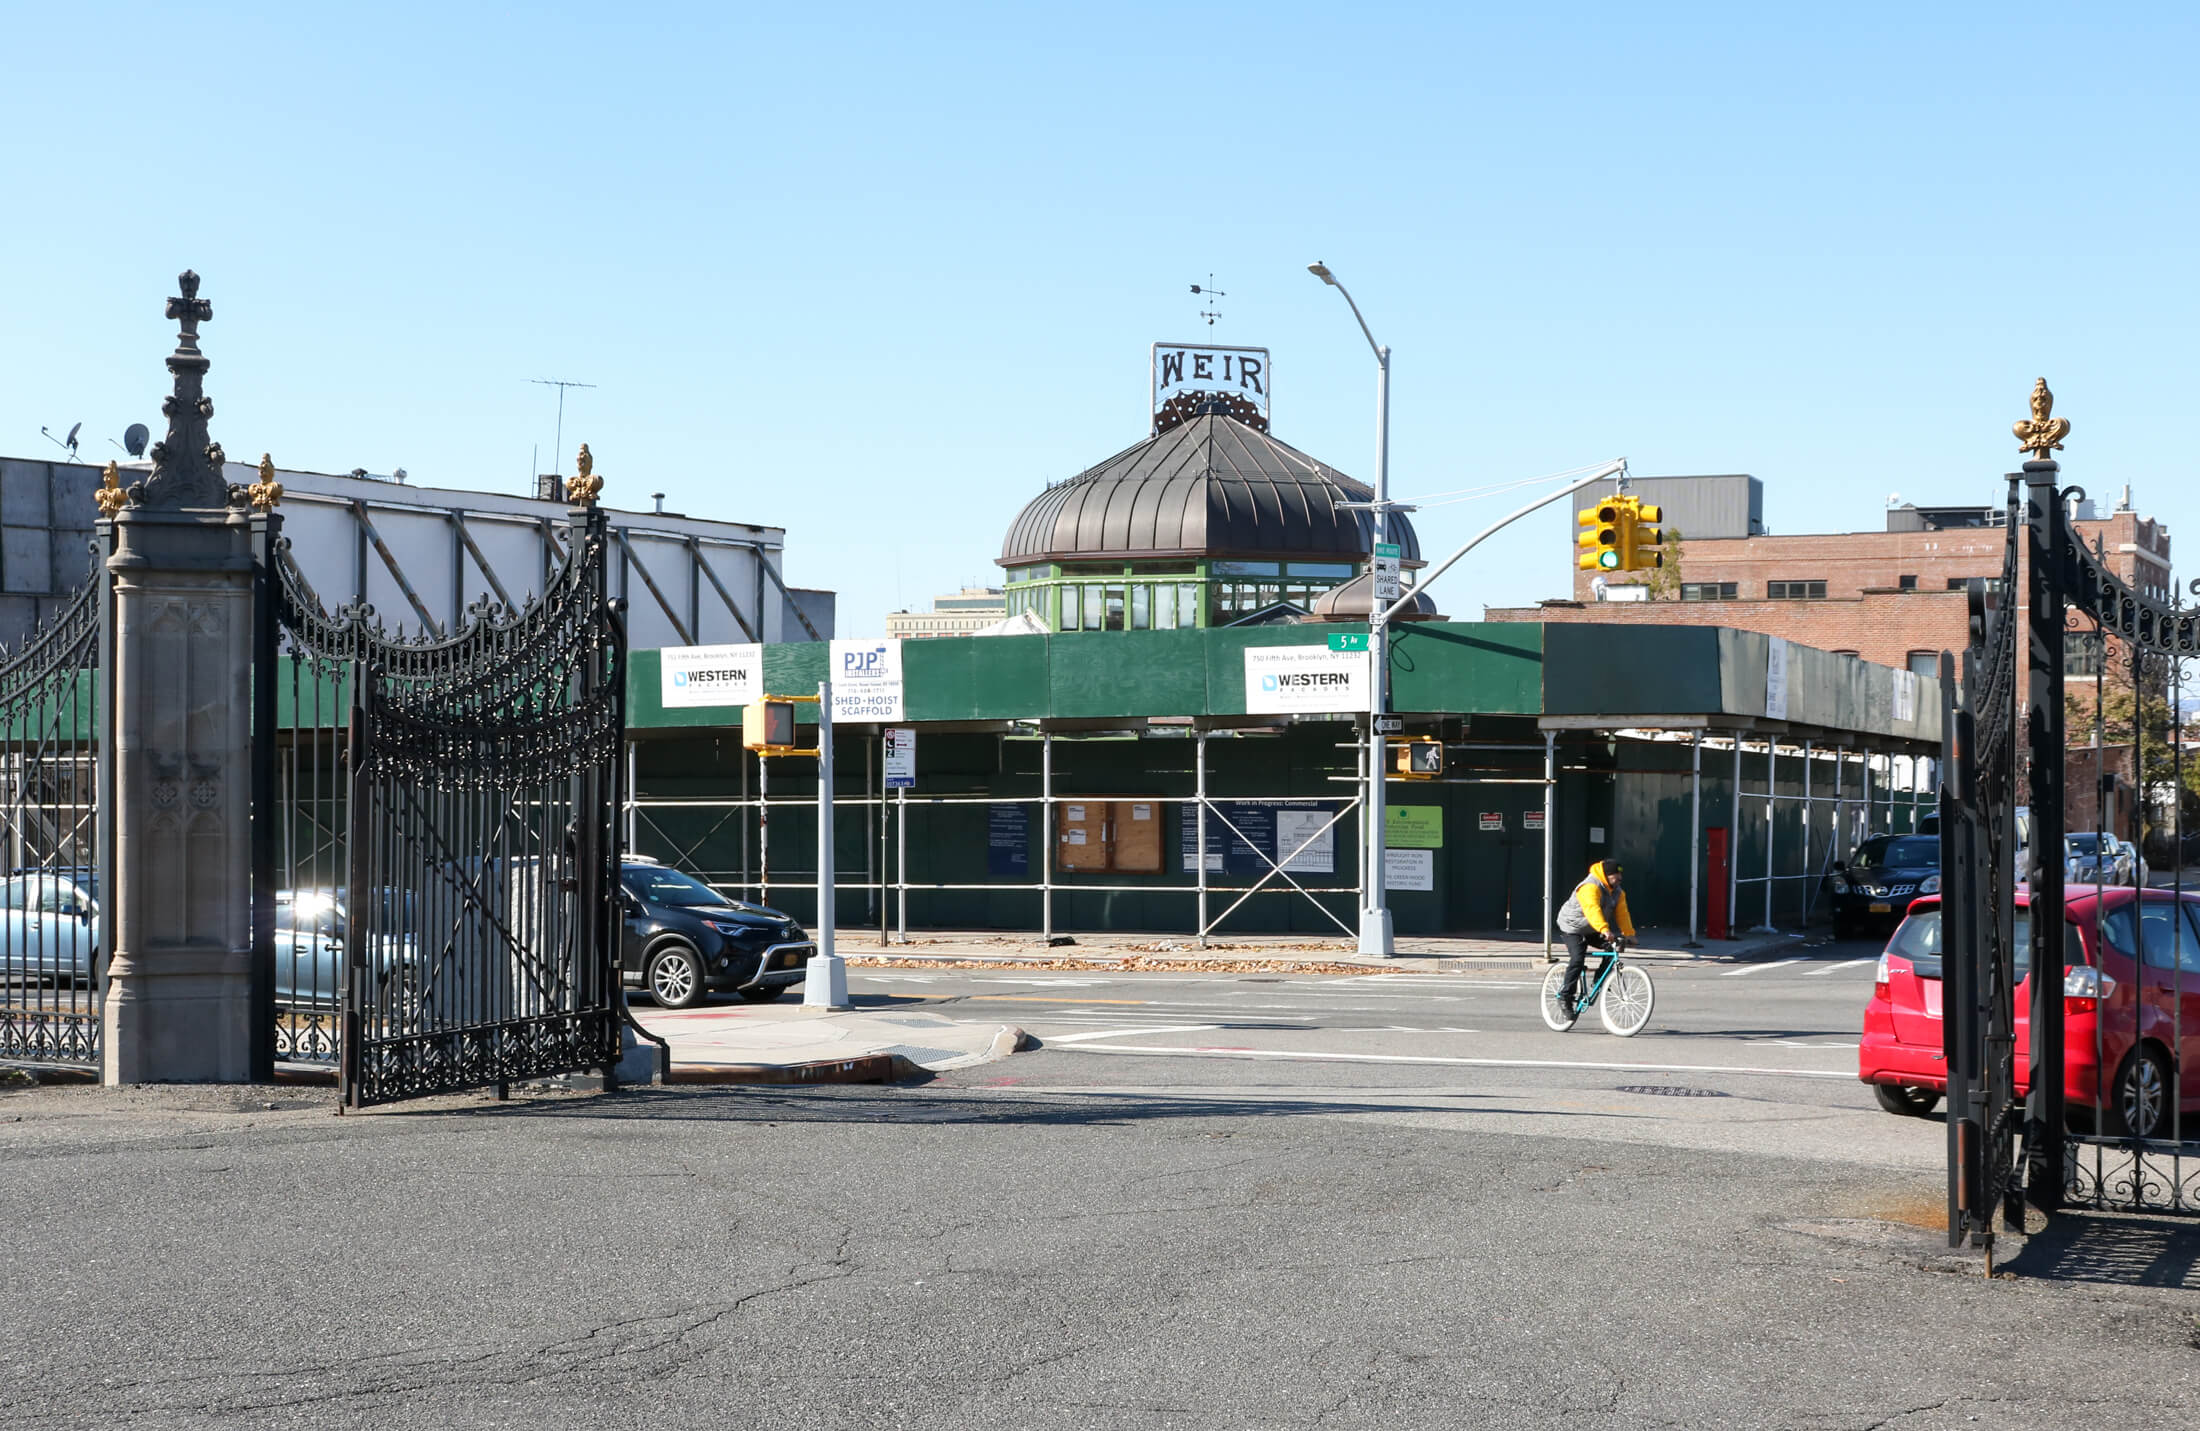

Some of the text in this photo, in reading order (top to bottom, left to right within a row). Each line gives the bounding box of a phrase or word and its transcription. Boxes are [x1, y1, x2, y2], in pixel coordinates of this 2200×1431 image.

[1160, 351, 1263, 394] WEIR
[1377, 575, 1397, 584] SHARED
[1380, 586, 1394, 595] LANE
[1341, 635, 1358, 648] 5 Av
[844, 652, 878, 671] PJP
[688, 669, 746, 682] WESTERN
[1278, 673, 1349, 686] WESTERN
[835, 696, 898, 706] SHED HOIST
[842, 706, 892, 716] SCAFFOLD
[1381, 720, 1401, 729] ONE WAY
